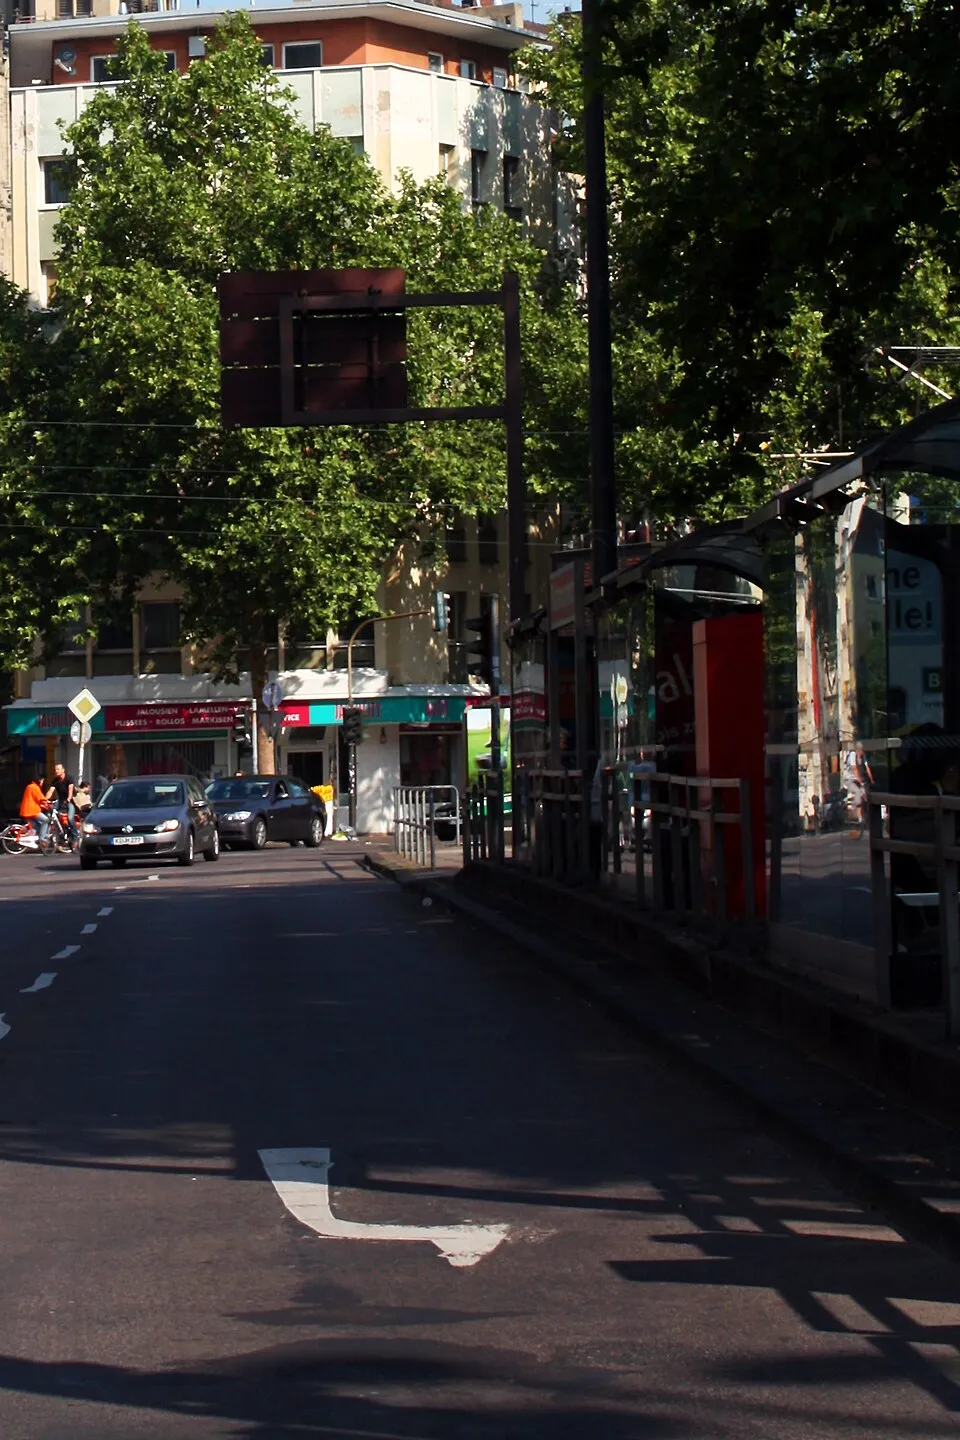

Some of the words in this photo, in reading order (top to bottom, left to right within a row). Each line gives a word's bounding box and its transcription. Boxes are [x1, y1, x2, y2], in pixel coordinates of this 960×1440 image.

[136, 707, 178, 716] JALOUSIEN
[156, 717, 186, 726] ROLLOS
[191, 716, 234, 725] MARKISEN
